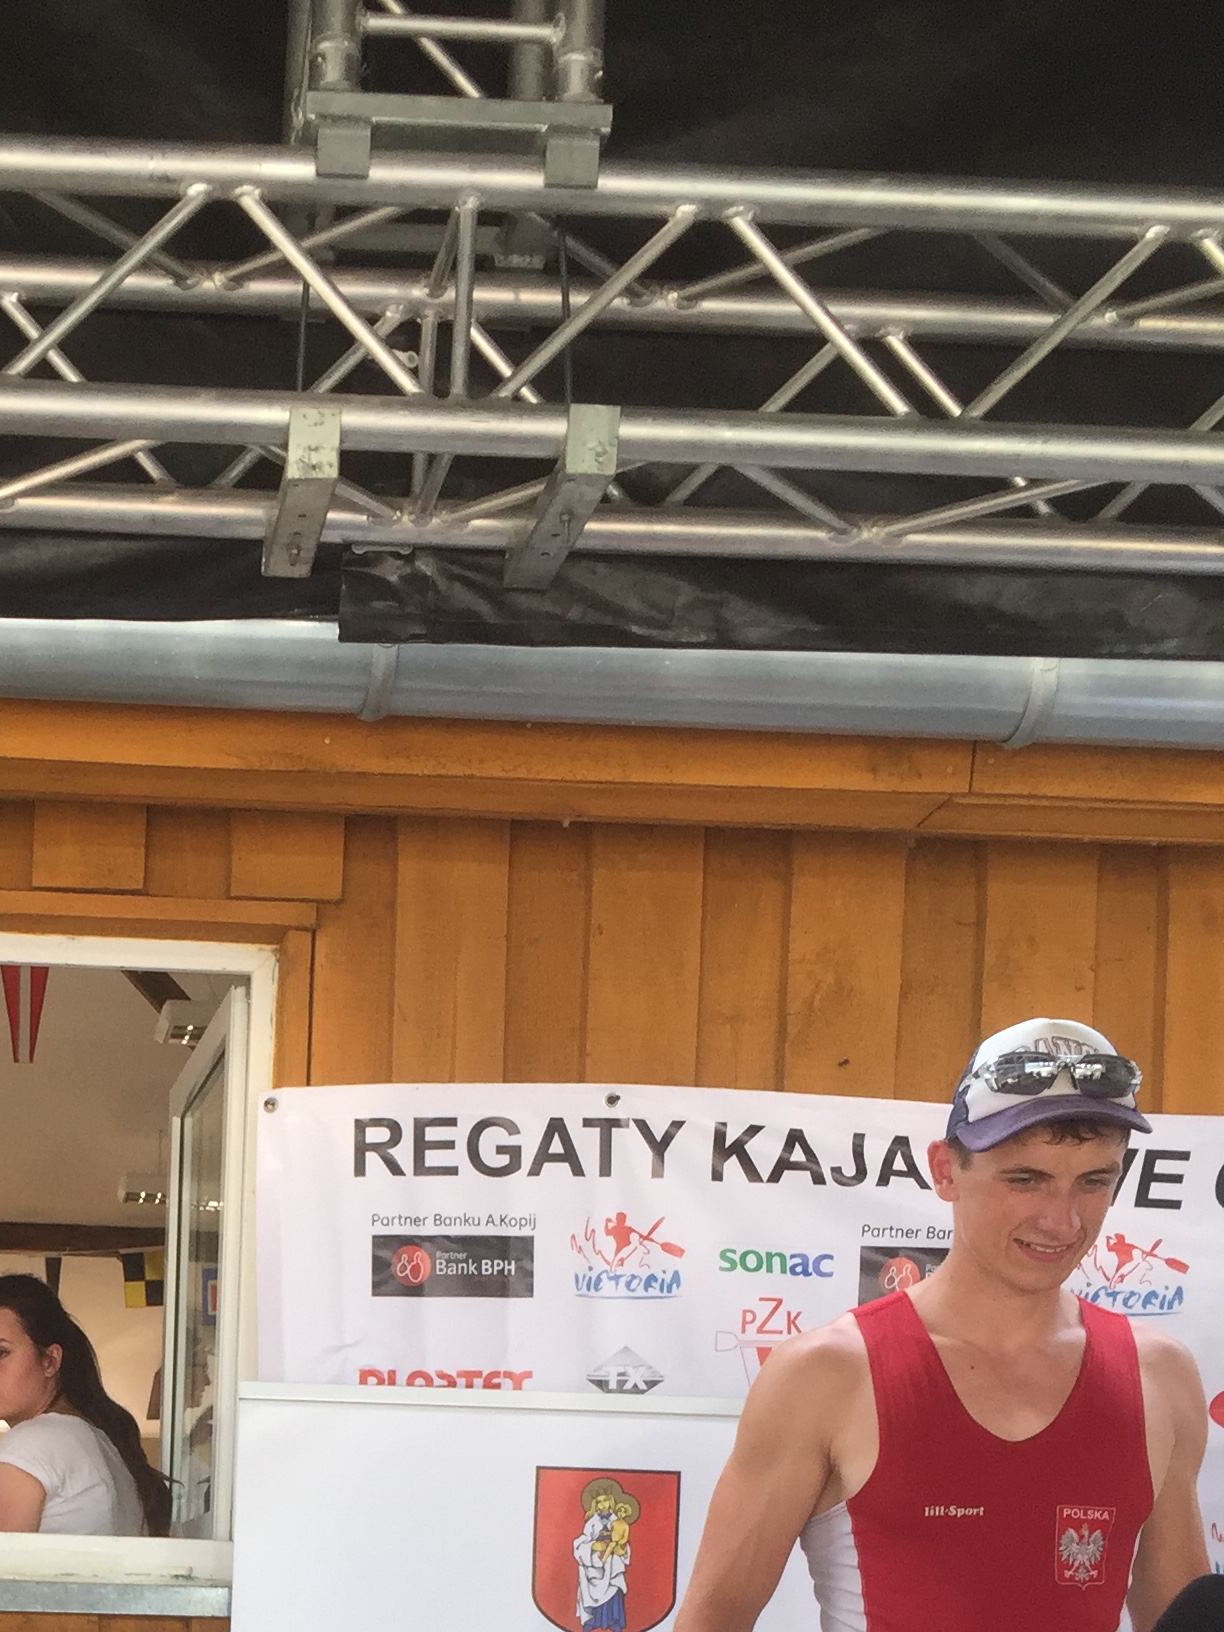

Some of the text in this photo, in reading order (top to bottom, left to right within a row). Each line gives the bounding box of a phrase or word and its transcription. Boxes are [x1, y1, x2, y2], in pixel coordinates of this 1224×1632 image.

[353, 1116, 686, 1180] REGATY
[371, 1212, 537, 1231] Partner Banku A.Kopij
[861, 1224, 922, 1240] Partner
[436, 1250, 468, 1260] Partner
[718, 1248, 835, 1278] sonac
[436, 1259, 515, 1276] Bank BPH
[740, 1297, 803, 1335] PZK
[1063, 1508, 1110, 1521] POLSKA
